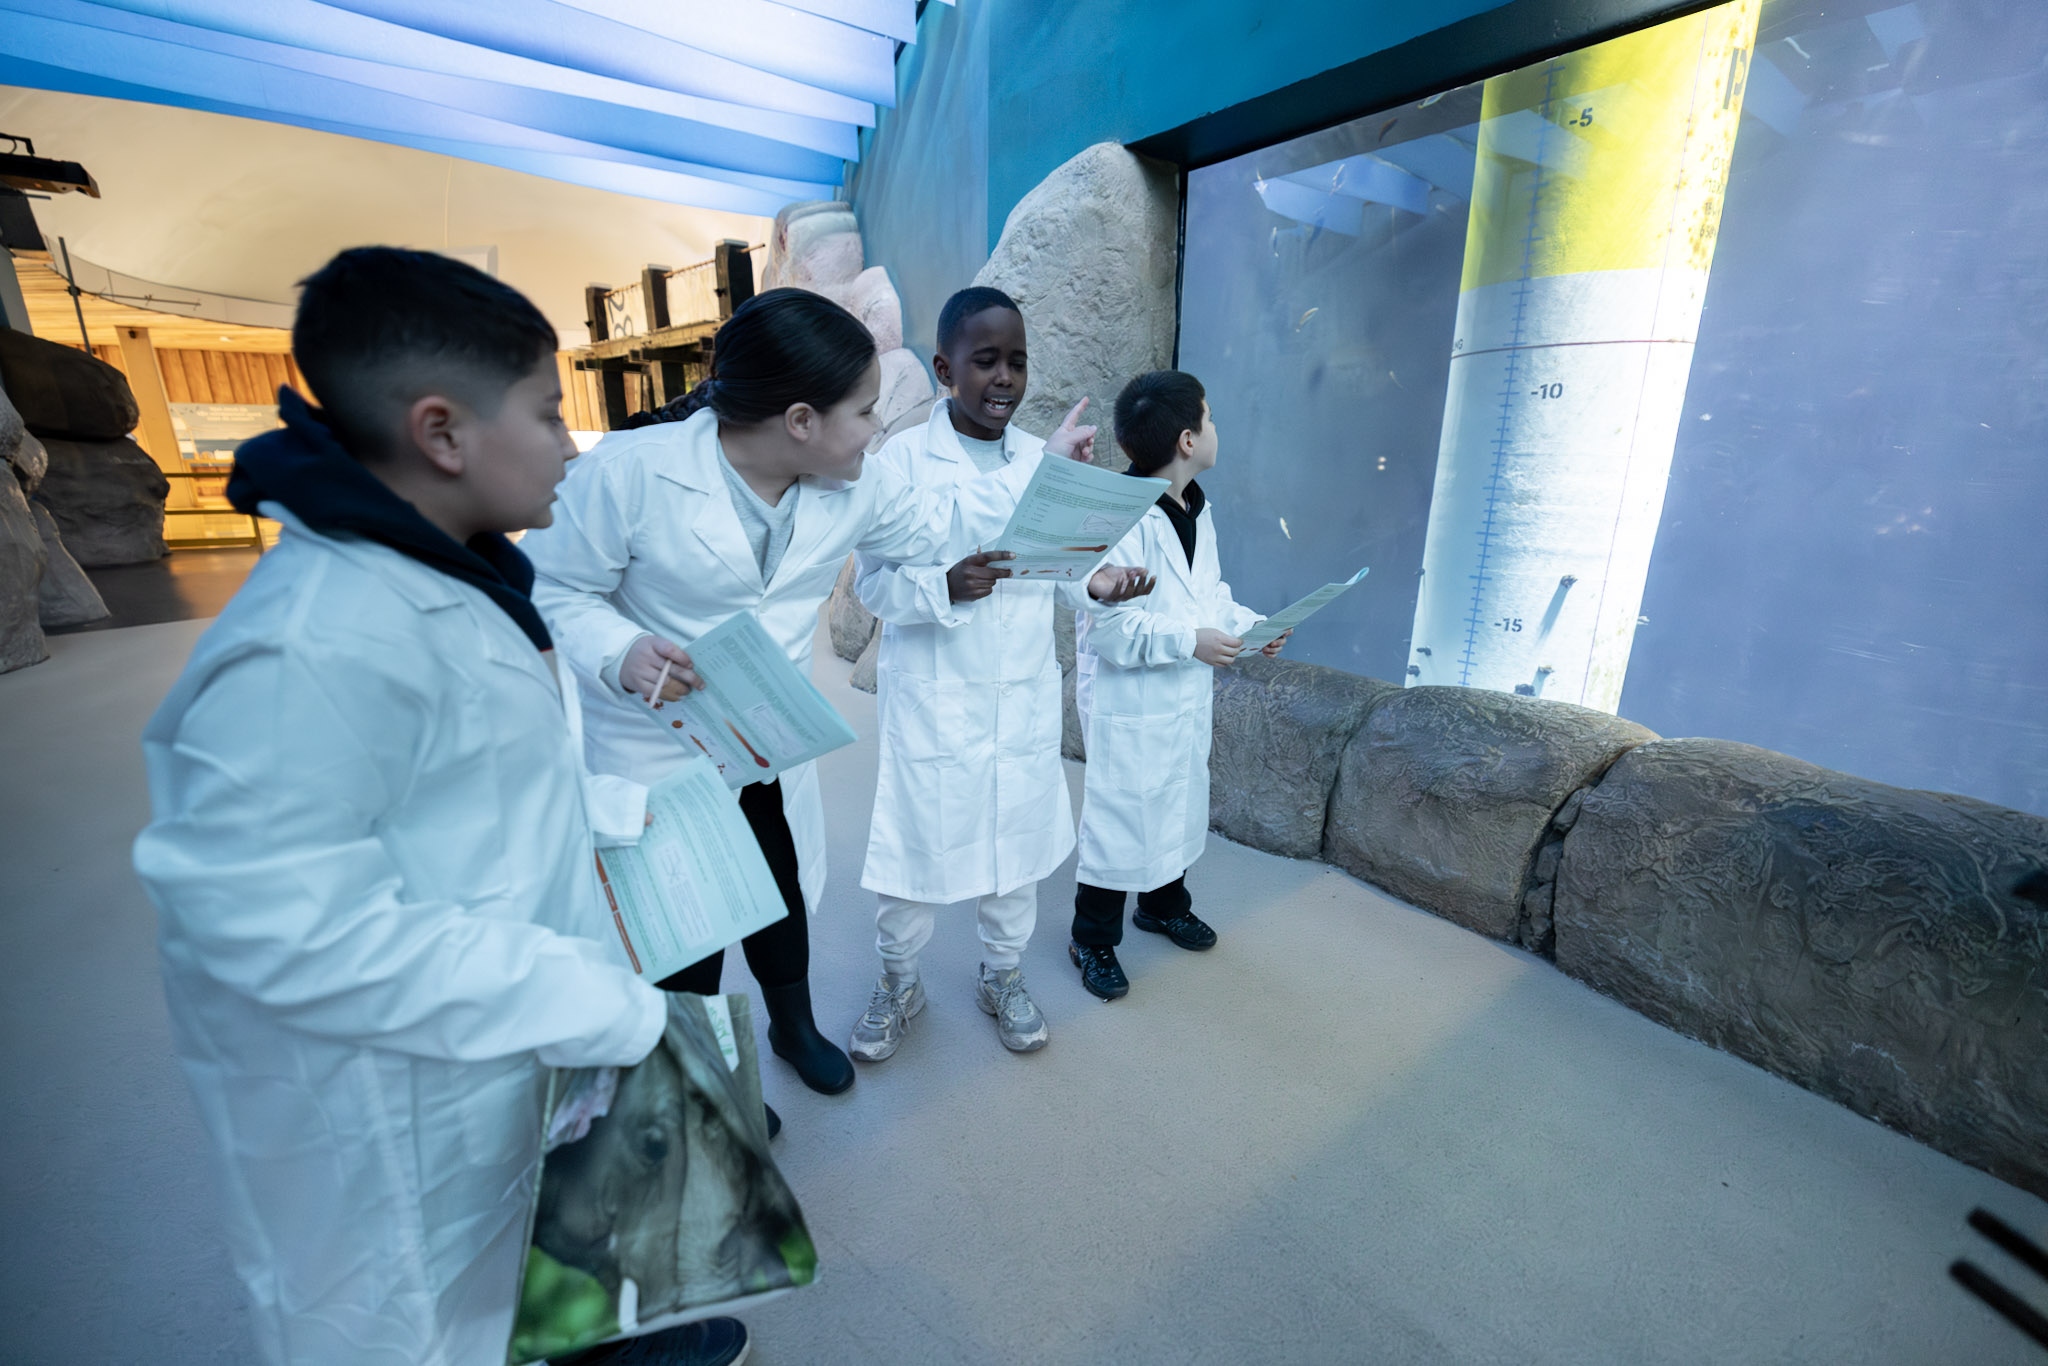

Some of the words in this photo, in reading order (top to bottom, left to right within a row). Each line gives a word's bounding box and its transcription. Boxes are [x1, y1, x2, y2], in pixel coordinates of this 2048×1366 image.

[1569, 107, 1593, 127] -5
[1530, 383, 1563, 399] -10
[1494, 618, 1522, 632] -15
